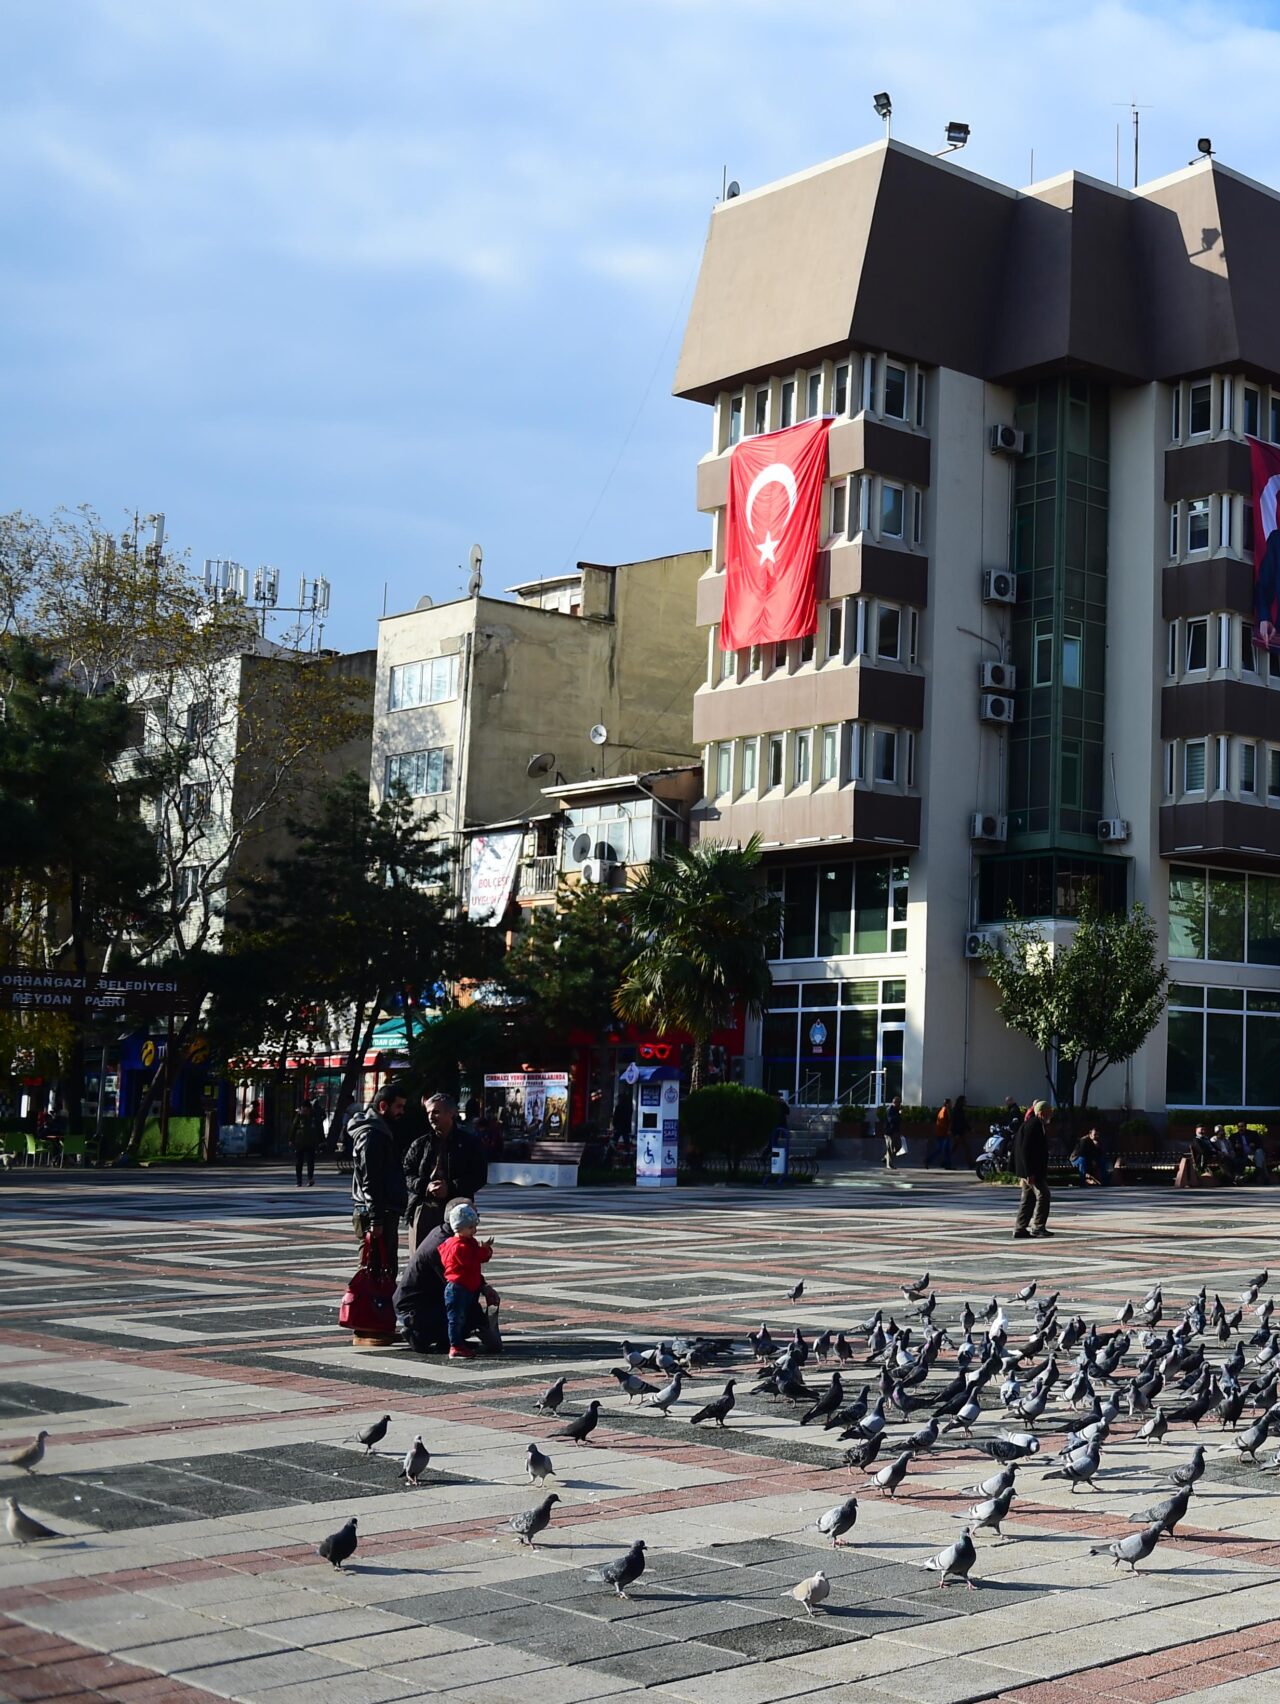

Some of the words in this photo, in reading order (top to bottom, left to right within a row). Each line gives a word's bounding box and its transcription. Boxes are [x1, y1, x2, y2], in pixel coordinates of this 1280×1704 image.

[3, 975, 87, 989] ORHANGAZİ
[99, 979, 178, 992] BELEDİYESİ
[12, 992, 72, 1006] MEYDAN
